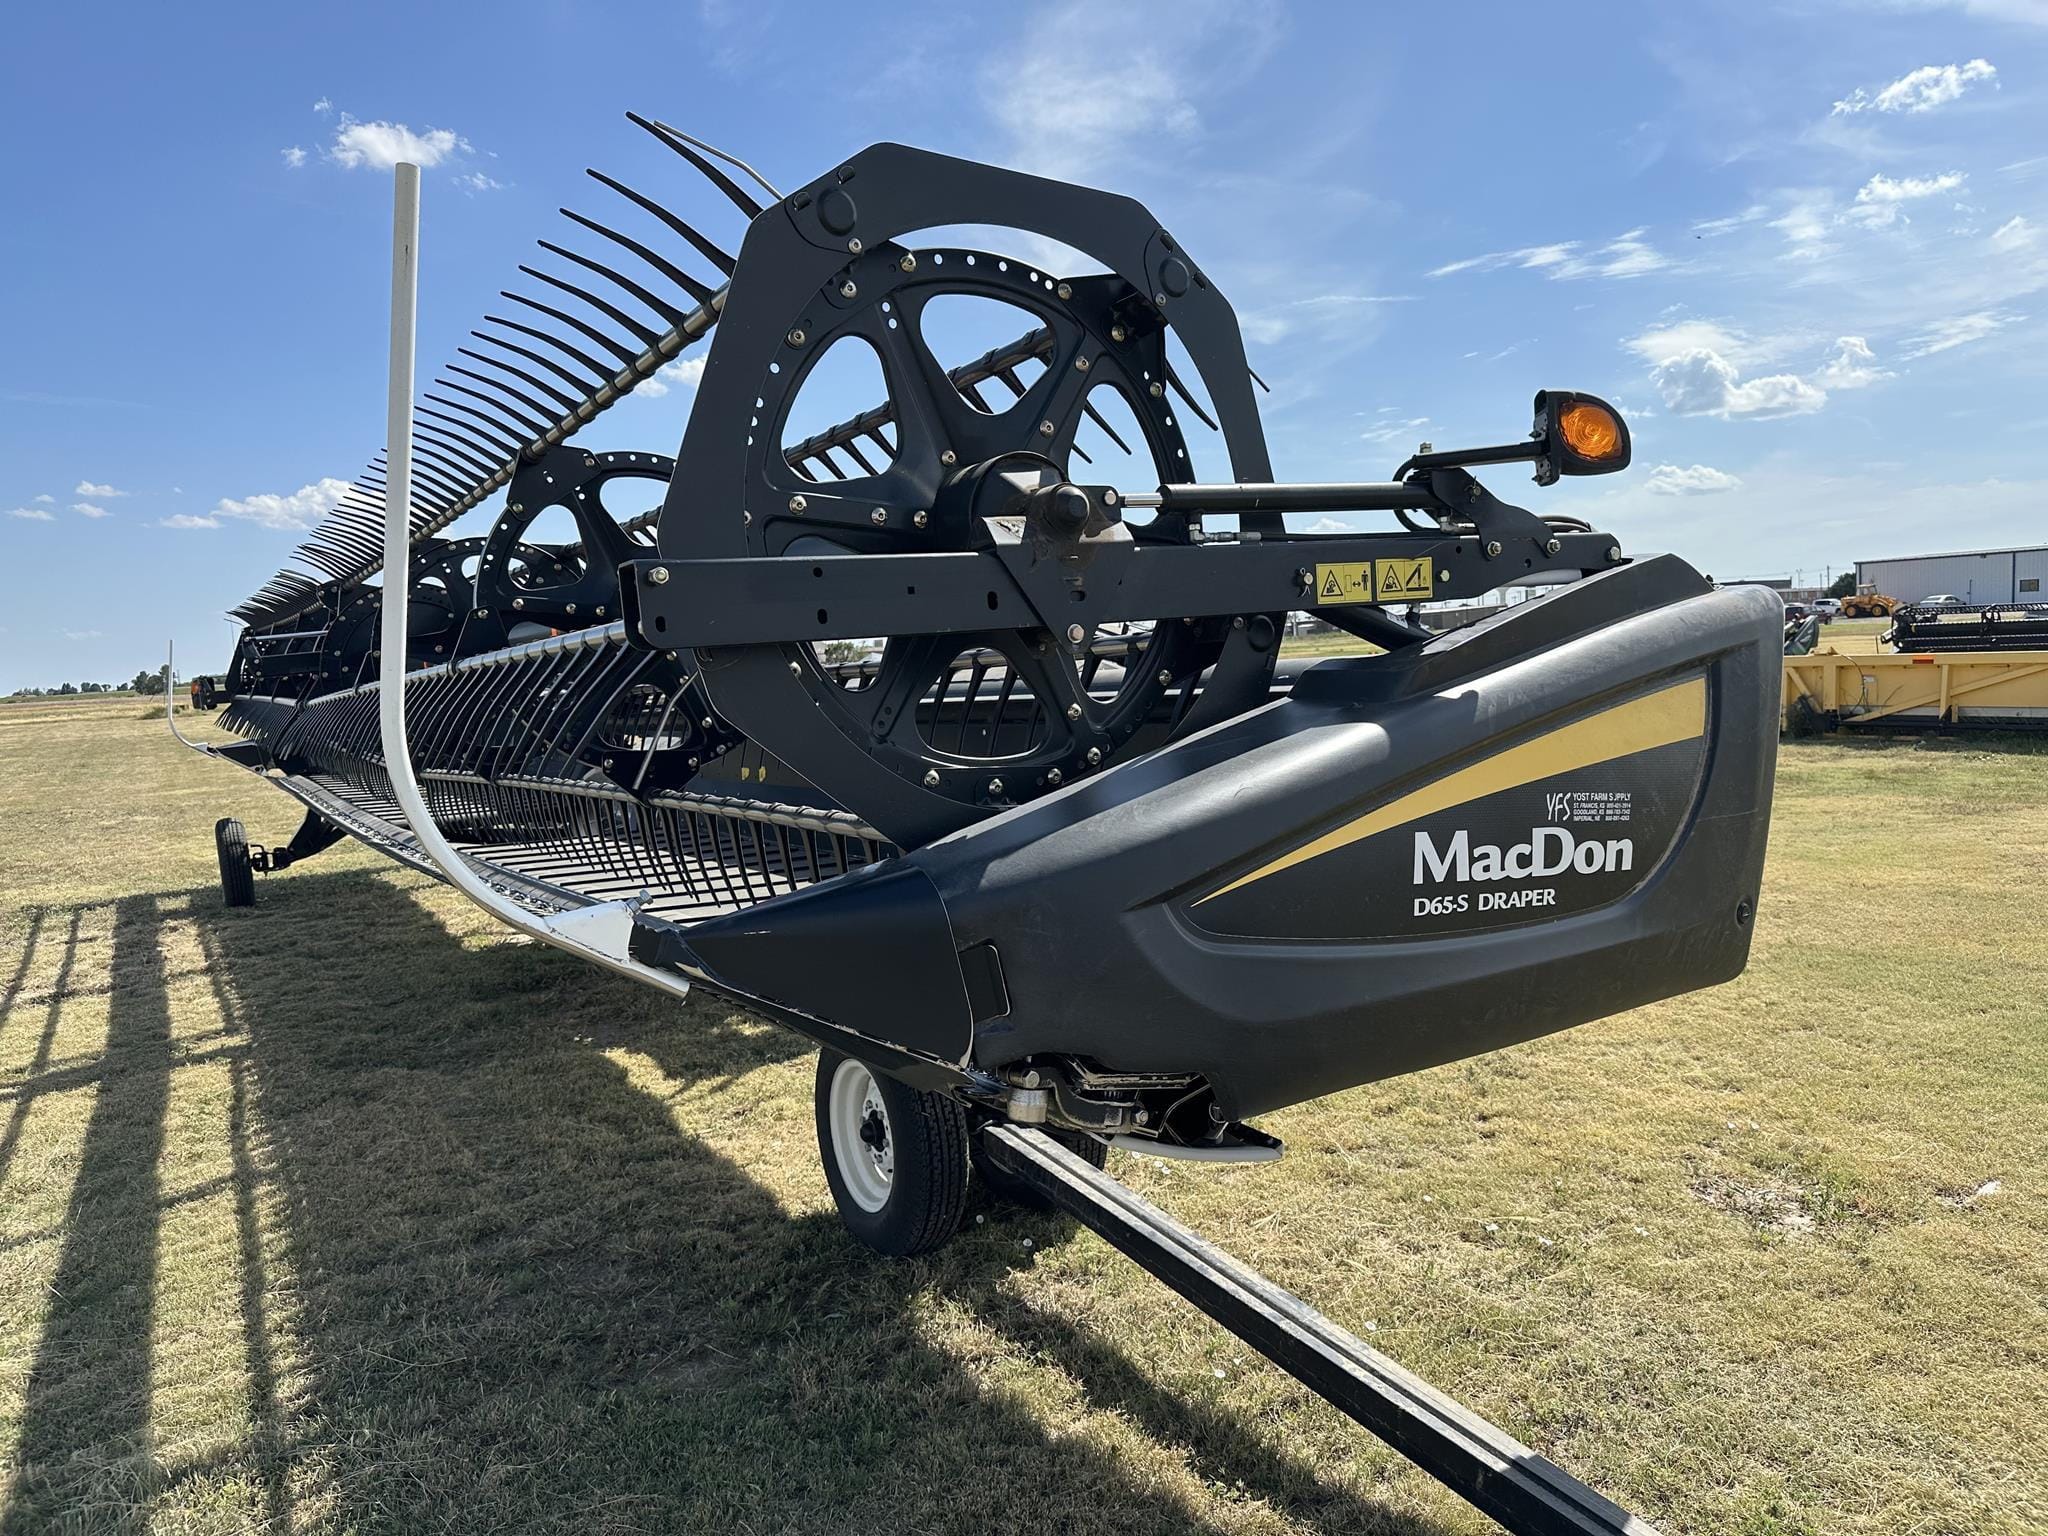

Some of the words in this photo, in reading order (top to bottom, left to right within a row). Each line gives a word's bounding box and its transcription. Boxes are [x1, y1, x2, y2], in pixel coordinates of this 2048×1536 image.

[1546, 792, 1571, 823] YFS
[1572, 792, 1590, 801] YOST
[1590, 792, 1608, 801] FARM
[1413, 827, 1633, 884] MacDon
[1413, 894, 1469, 917] D65-S
[1478, 888, 1556, 911] DRAPER
